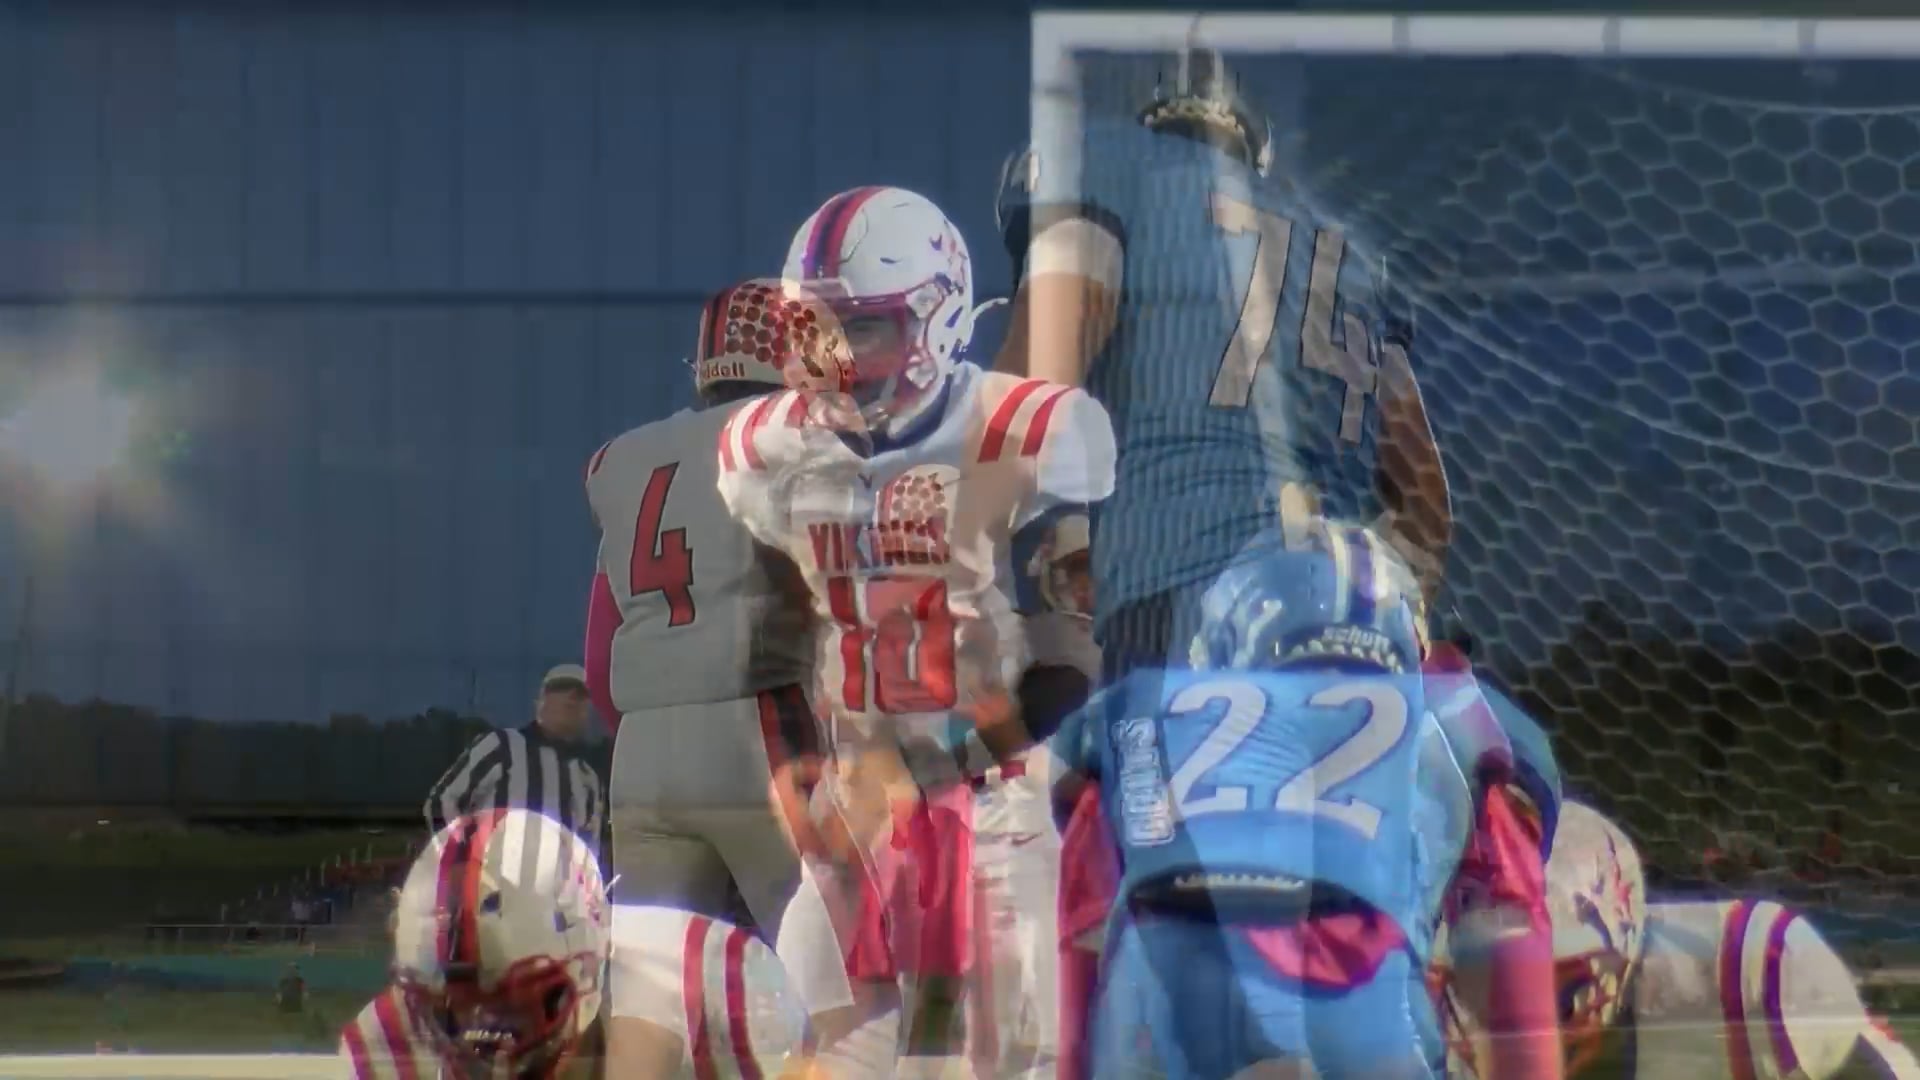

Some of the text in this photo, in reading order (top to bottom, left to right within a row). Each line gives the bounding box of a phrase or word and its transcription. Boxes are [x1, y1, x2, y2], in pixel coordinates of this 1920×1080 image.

[1209, 190, 1379, 444] 74
[630, 462, 695, 628] 4
[826, 575, 957, 714] 10
[1166, 682, 1408, 840] 22
